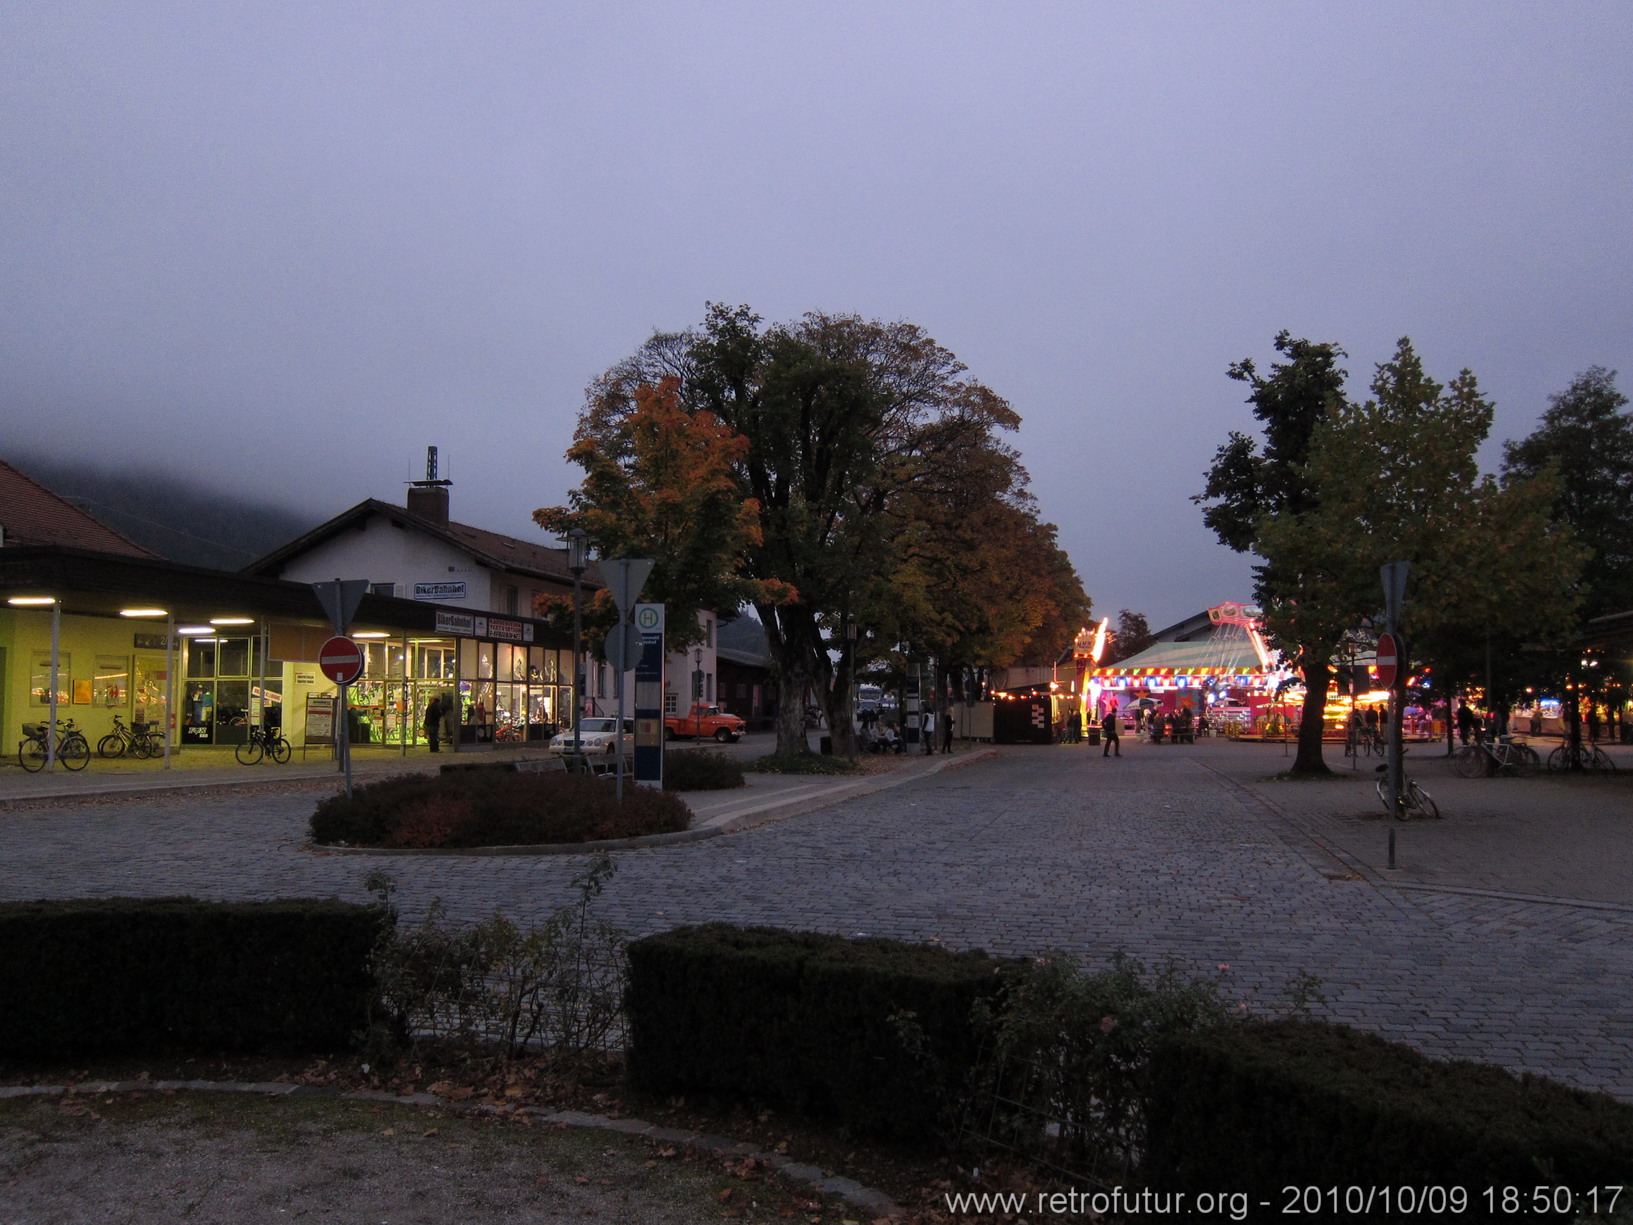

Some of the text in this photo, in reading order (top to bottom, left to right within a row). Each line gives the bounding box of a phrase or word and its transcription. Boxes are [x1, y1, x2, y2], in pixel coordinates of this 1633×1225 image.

[416, 585, 464, 594] BikerBahnhof
[438, 614, 472, 628] BikerBahnhof
[644, 612, 653, 625] H
